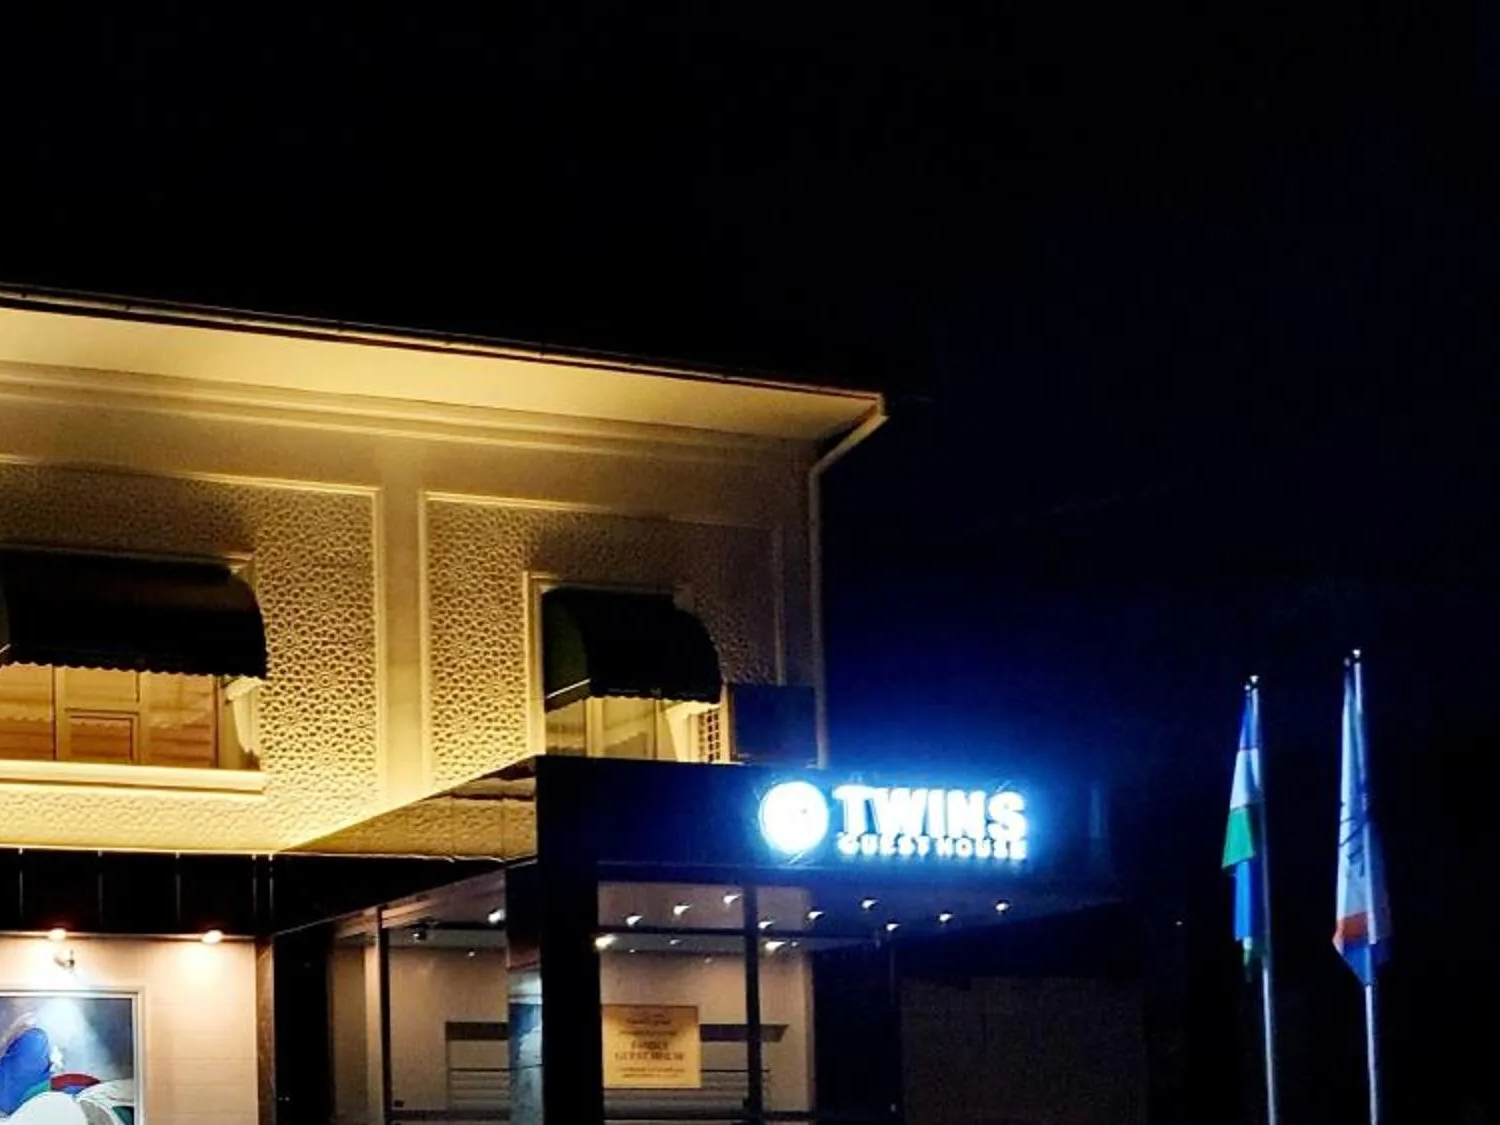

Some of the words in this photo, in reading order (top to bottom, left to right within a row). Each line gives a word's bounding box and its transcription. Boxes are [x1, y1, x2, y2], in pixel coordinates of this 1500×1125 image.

[834, 785, 1027, 840] TWINS
[838, 834, 930, 856] GUEST
[935, 836, 1027, 860] HOUSE
